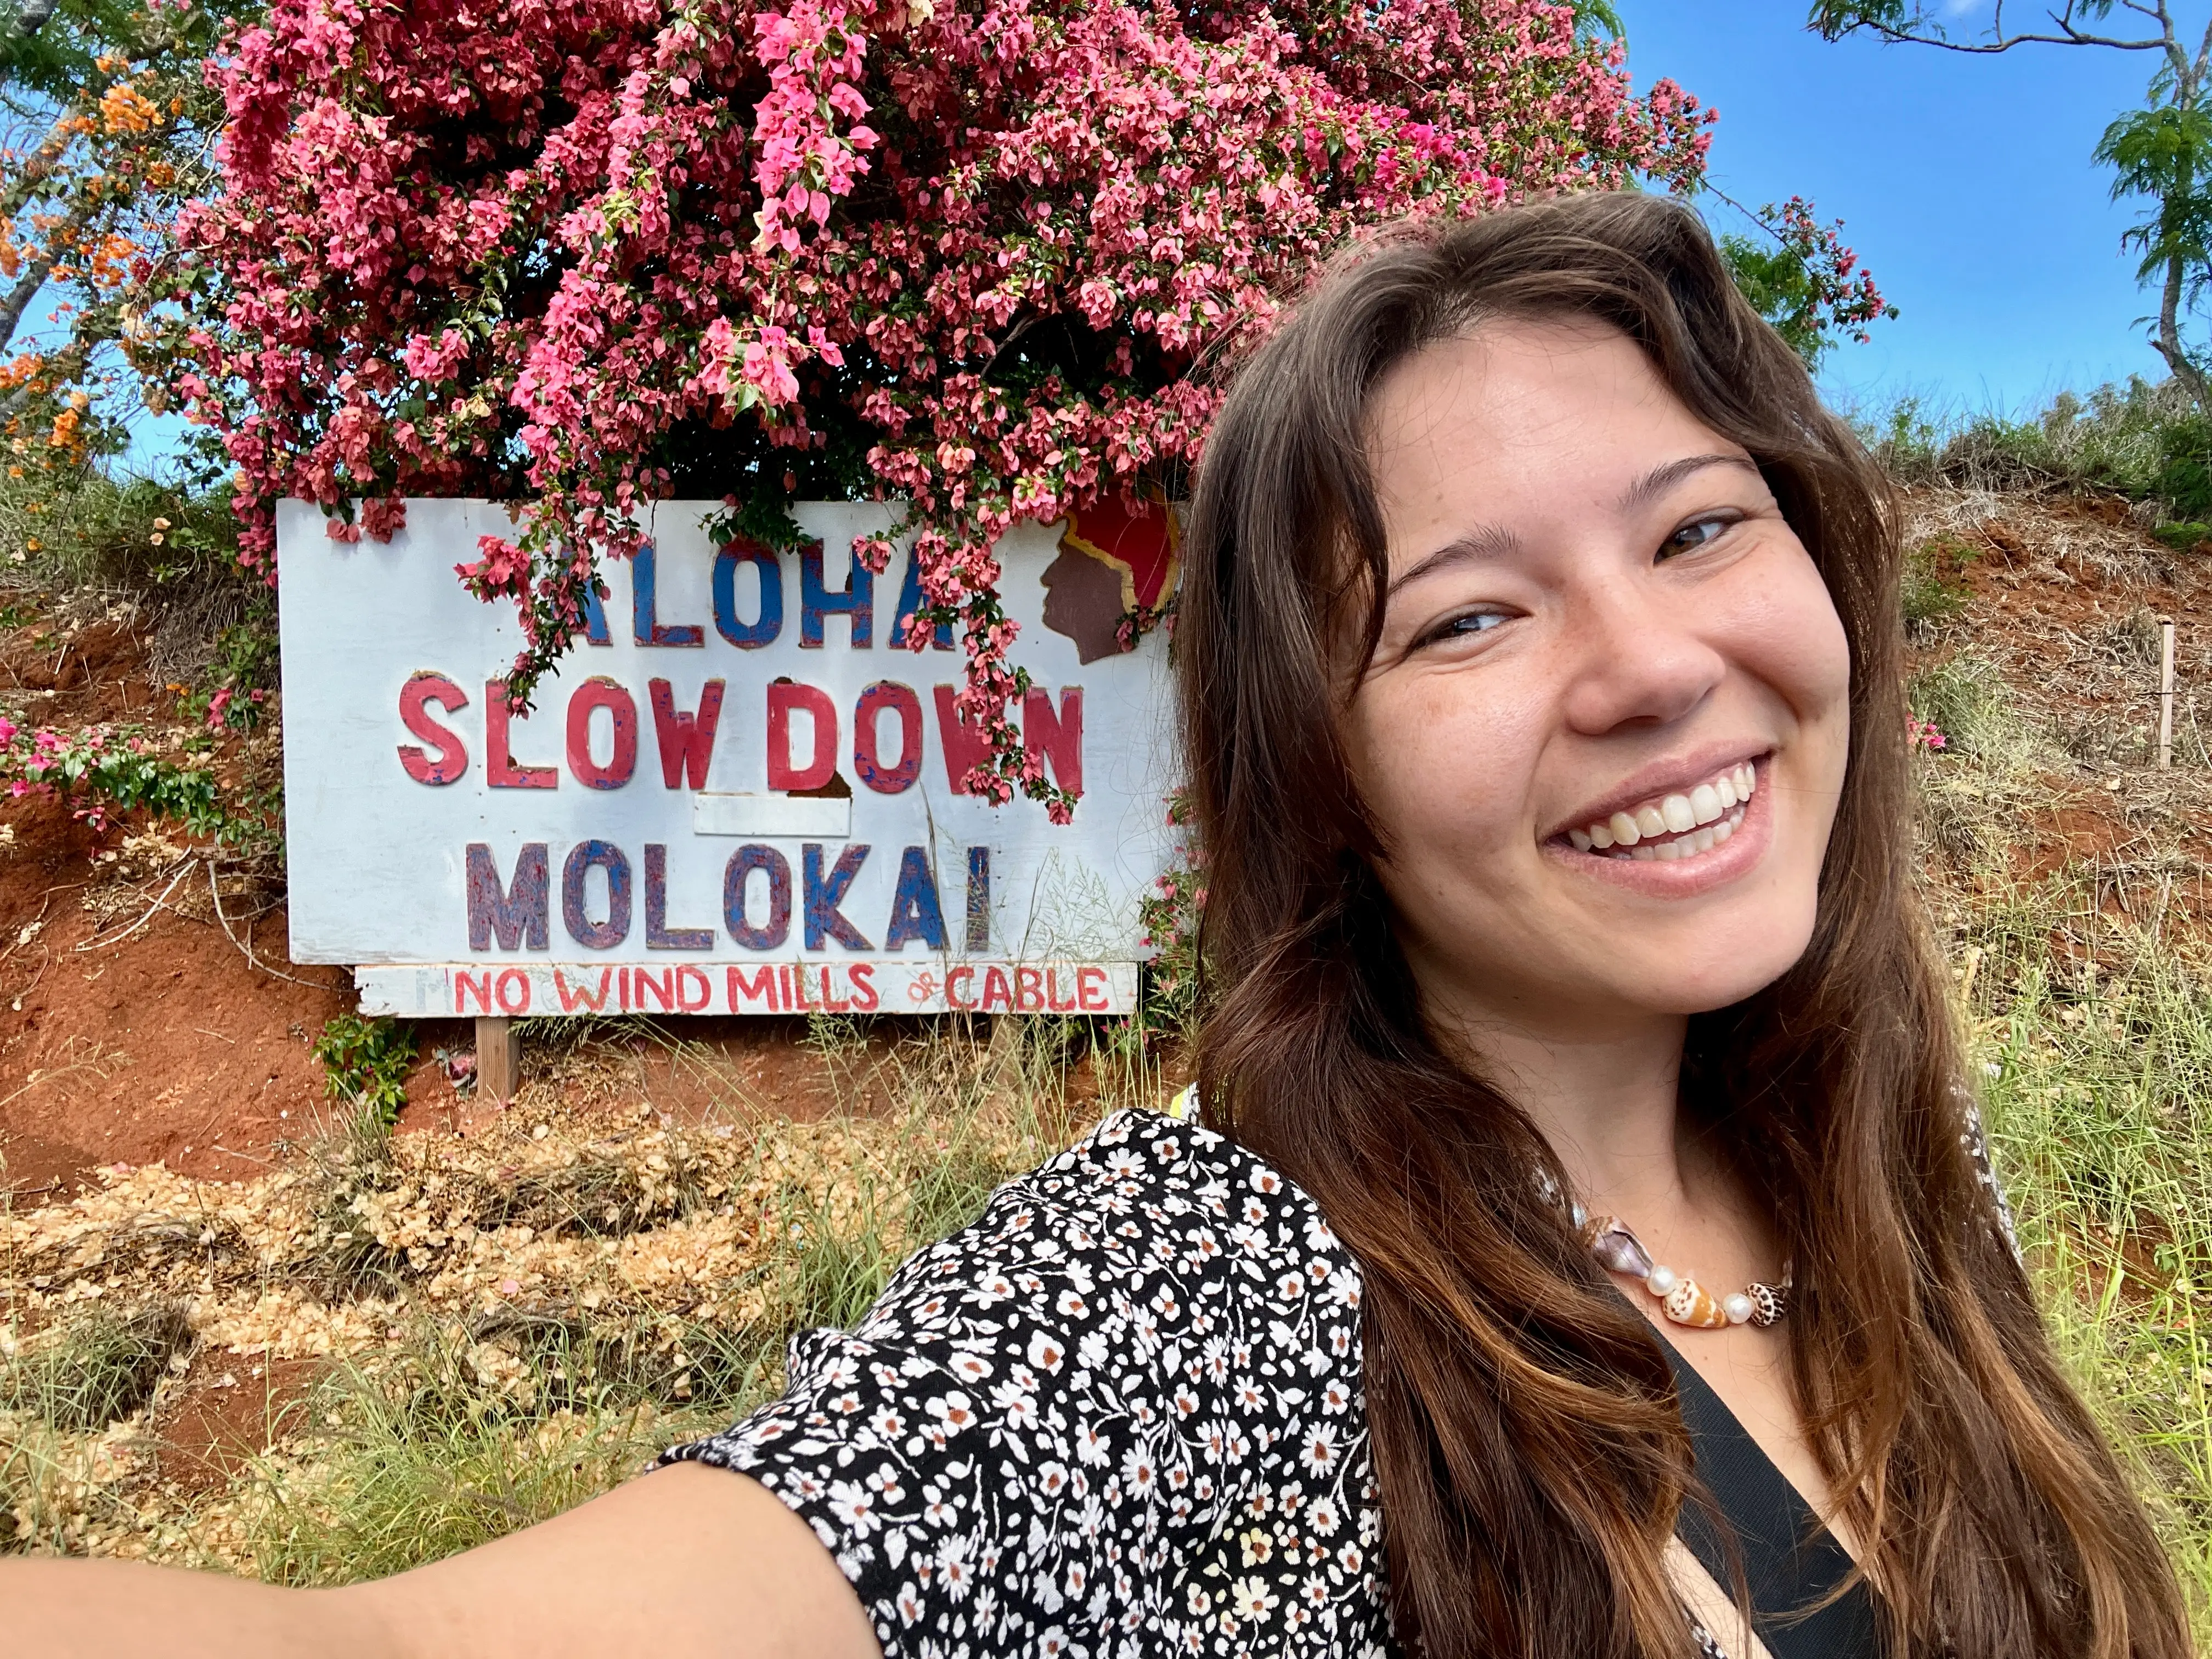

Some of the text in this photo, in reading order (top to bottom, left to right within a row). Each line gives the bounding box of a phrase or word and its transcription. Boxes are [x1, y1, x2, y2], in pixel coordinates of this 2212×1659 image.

[397, 672, 1084, 795] SLOW DOWN
[465, 839, 990, 952] MOLOKAI
[455, 968, 531, 1014] NO
[553, 966, 712, 1013] WIND
[726, 963, 880, 1014] MILLS
[945, 966, 1110, 1013] CABLE
